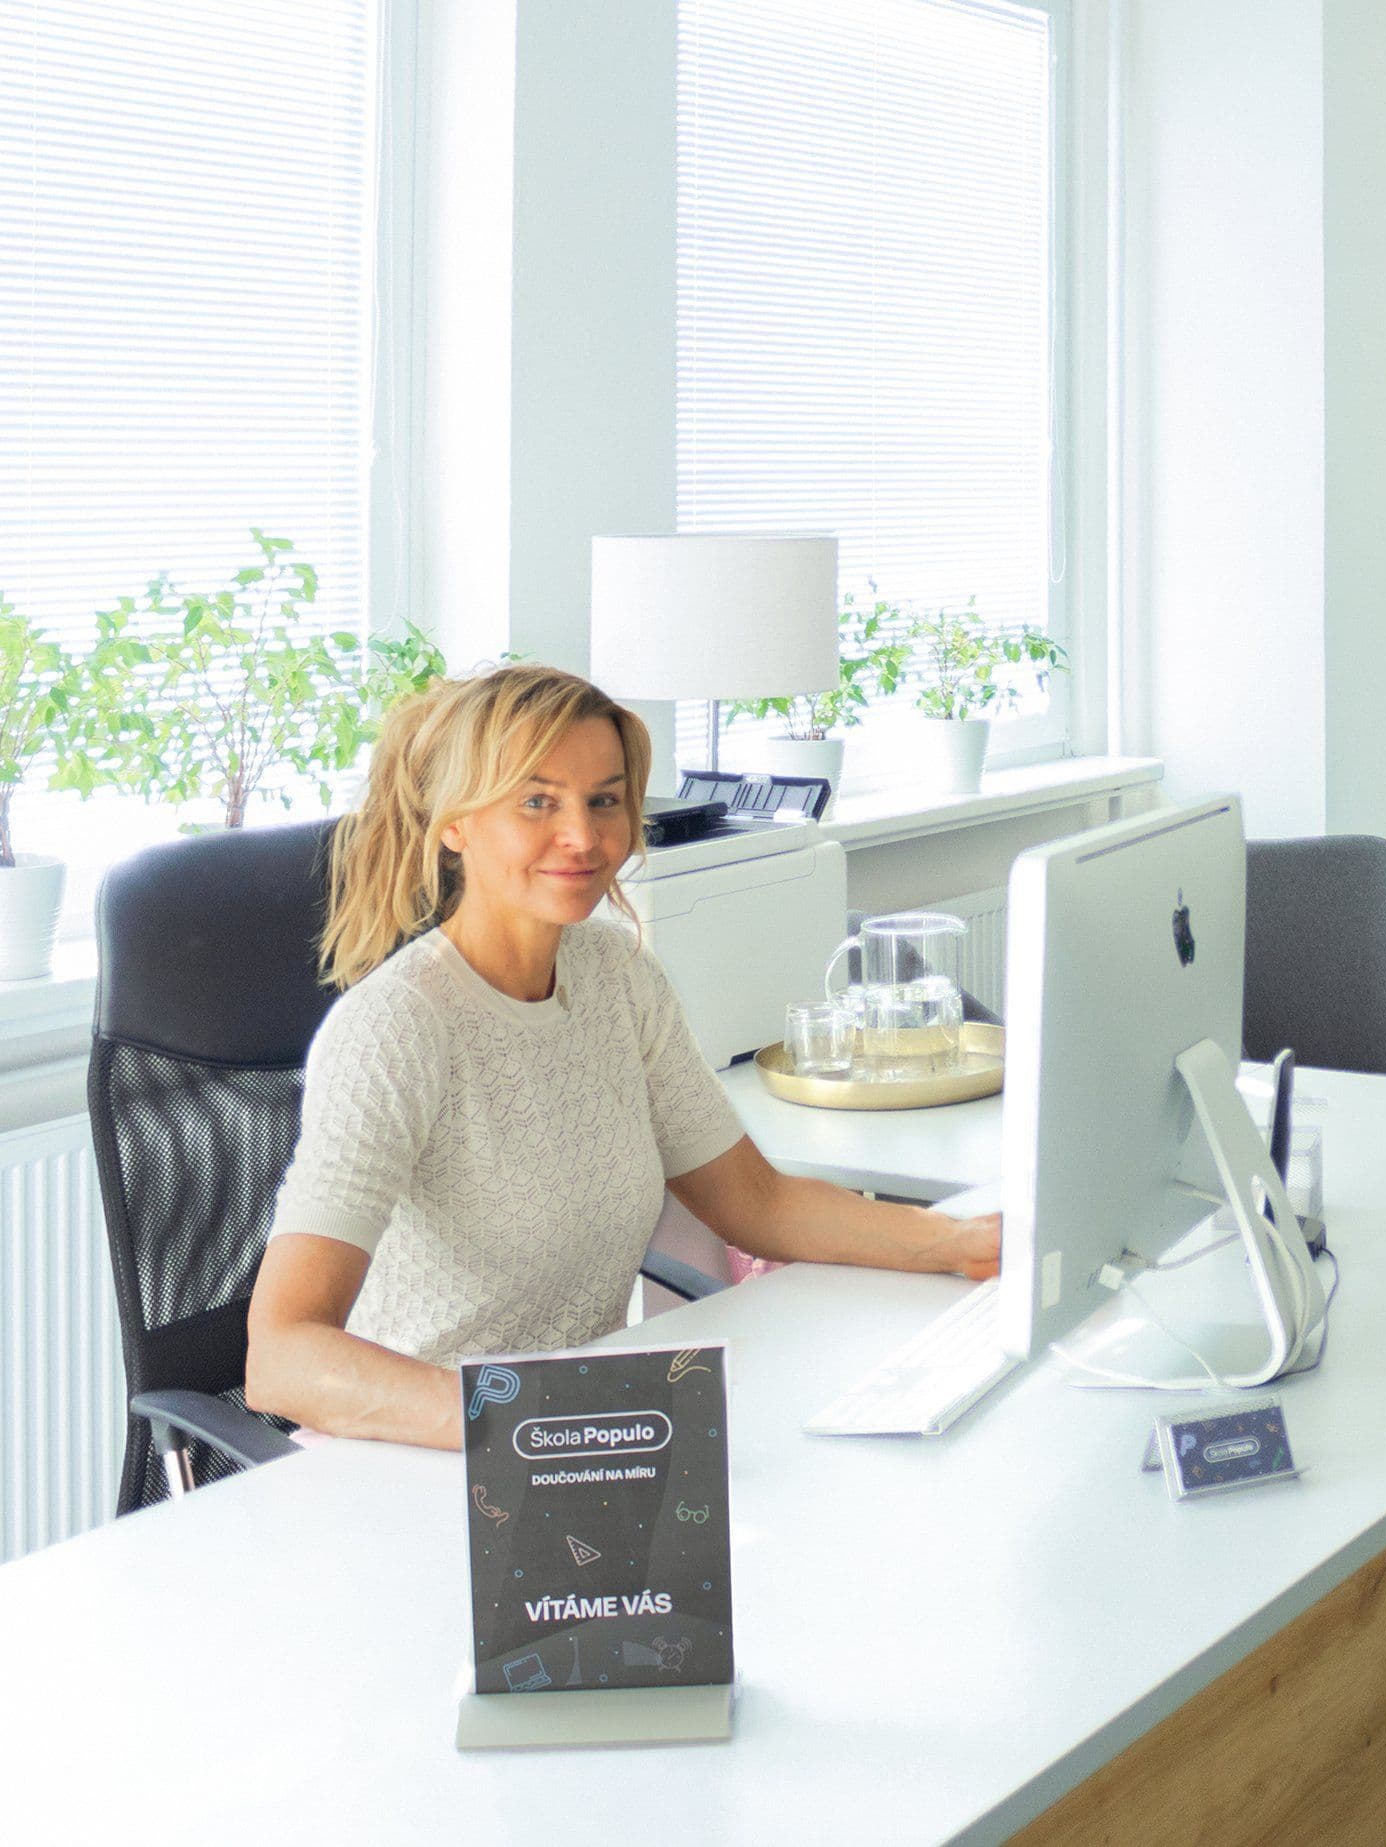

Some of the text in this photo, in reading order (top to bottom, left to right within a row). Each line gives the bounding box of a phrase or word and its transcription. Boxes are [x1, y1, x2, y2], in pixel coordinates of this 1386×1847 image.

[530, 1423, 655, 1449] Škola Populo
[531, 1465, 656, 1486] DOUČOVÁNÍ NA MÍRU
[525, 1588, 673, 1622] VÍTÁME VÁS
